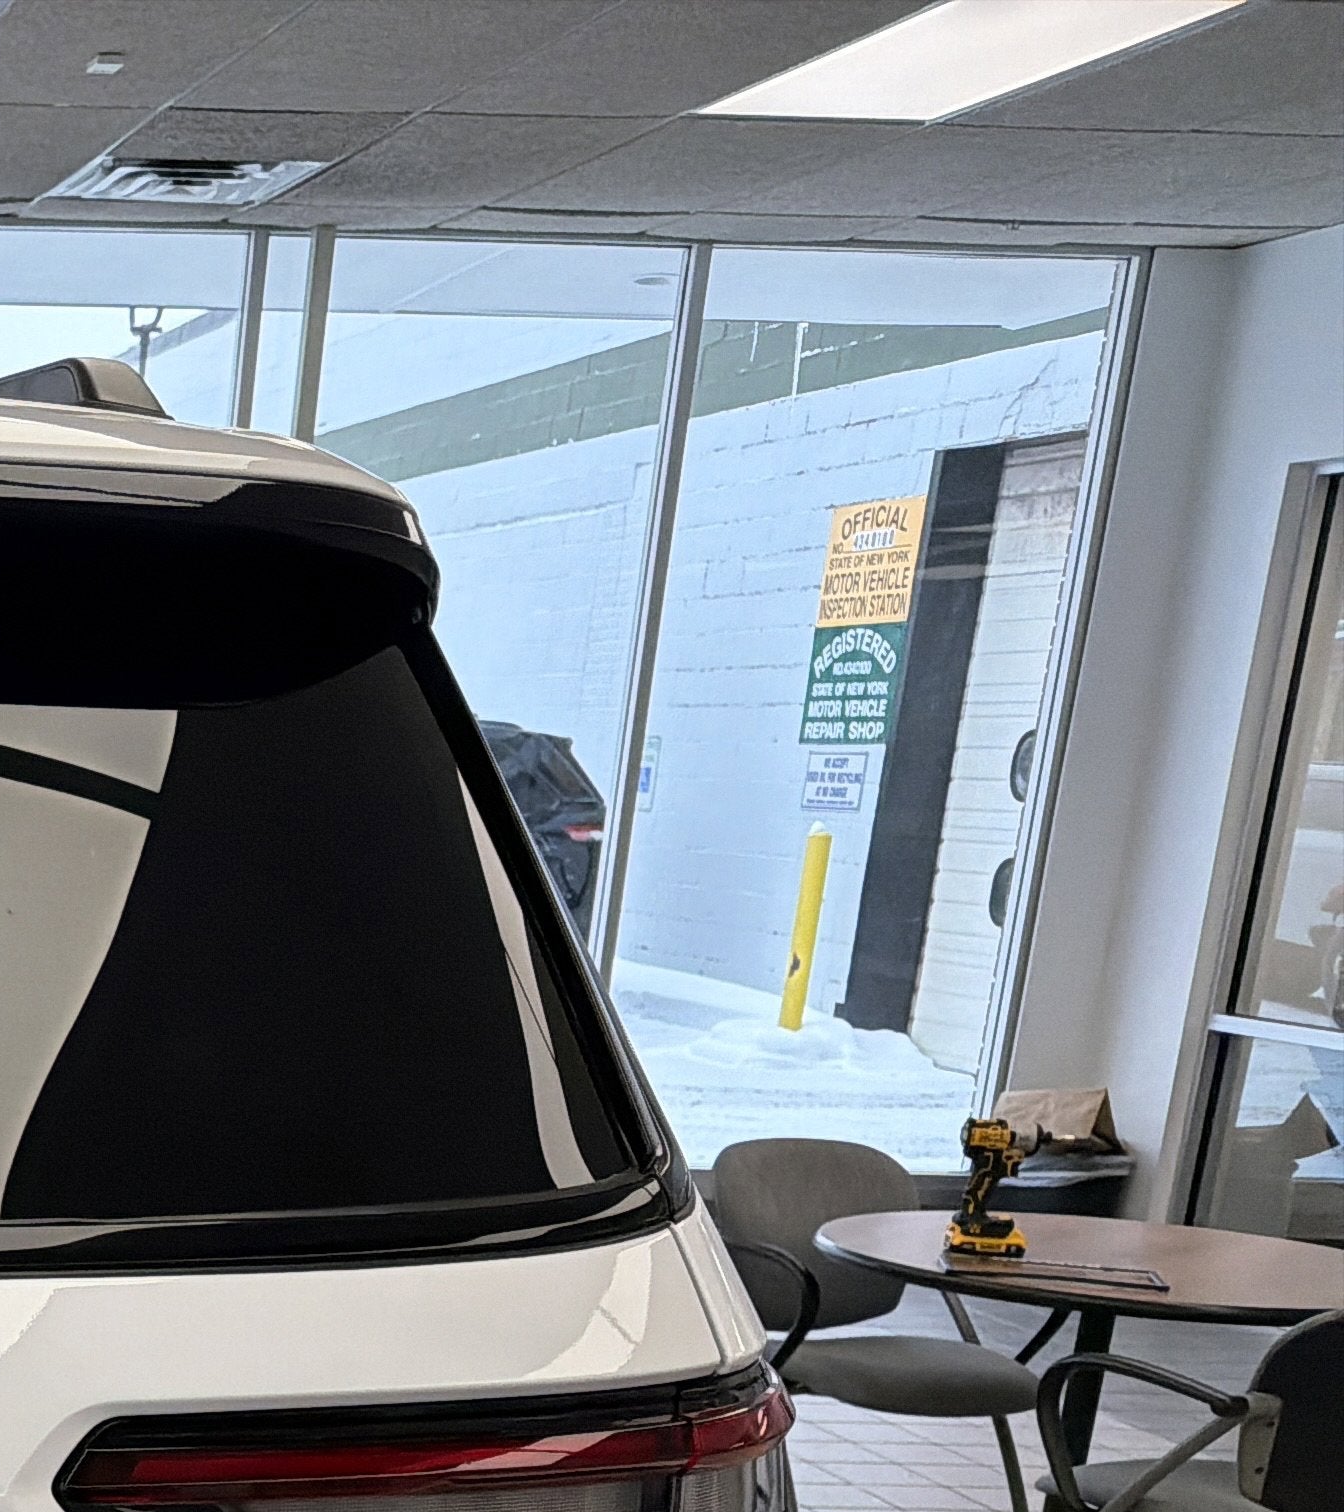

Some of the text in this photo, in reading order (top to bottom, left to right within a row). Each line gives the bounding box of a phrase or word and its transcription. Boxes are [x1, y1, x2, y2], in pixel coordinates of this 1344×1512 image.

[841, 505, 908, 540] OFFICIAL
[829, 550, 910, 571] STATE OF NEW YORK
[823, 566, 910, 596] MOTOR VEHICLE
[819, 592, 908, 620] INSPECTION STATION
[814, 628, 897, 679] REGISTERED
[812, 681, 889, 697] STATE OF NEW YORK
[808, 699, 888, 718] MOTOR VEHICLE
[804, 721, 885, 740] REPAIR SHOP
